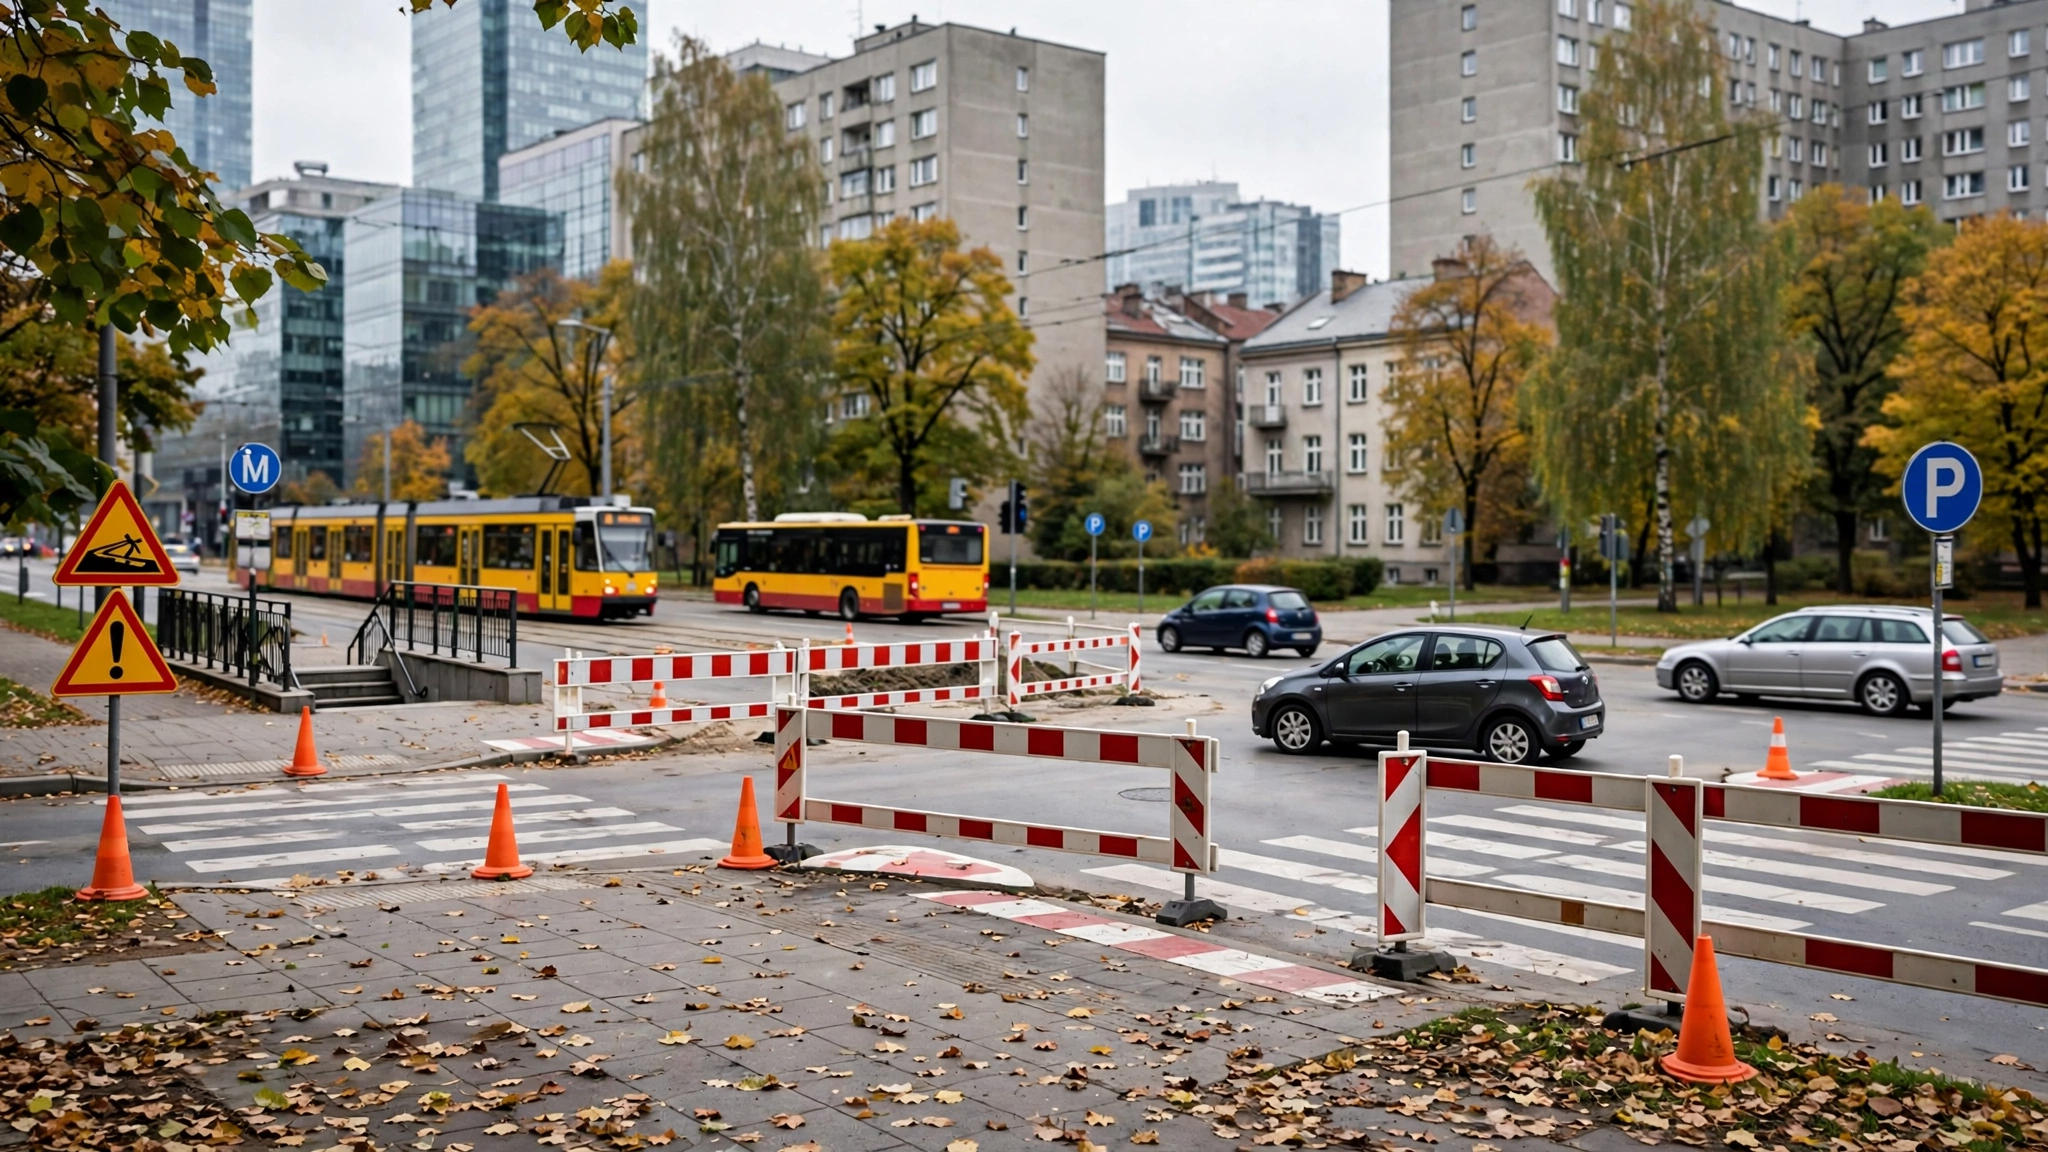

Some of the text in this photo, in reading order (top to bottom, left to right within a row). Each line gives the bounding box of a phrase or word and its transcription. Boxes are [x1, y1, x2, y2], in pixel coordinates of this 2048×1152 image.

[242, 454, 269, 484] M
[1926, 457, 1966, 519] P
[1090, 517, 1101, 533] P
[1138, 523, 1149, 539] P
